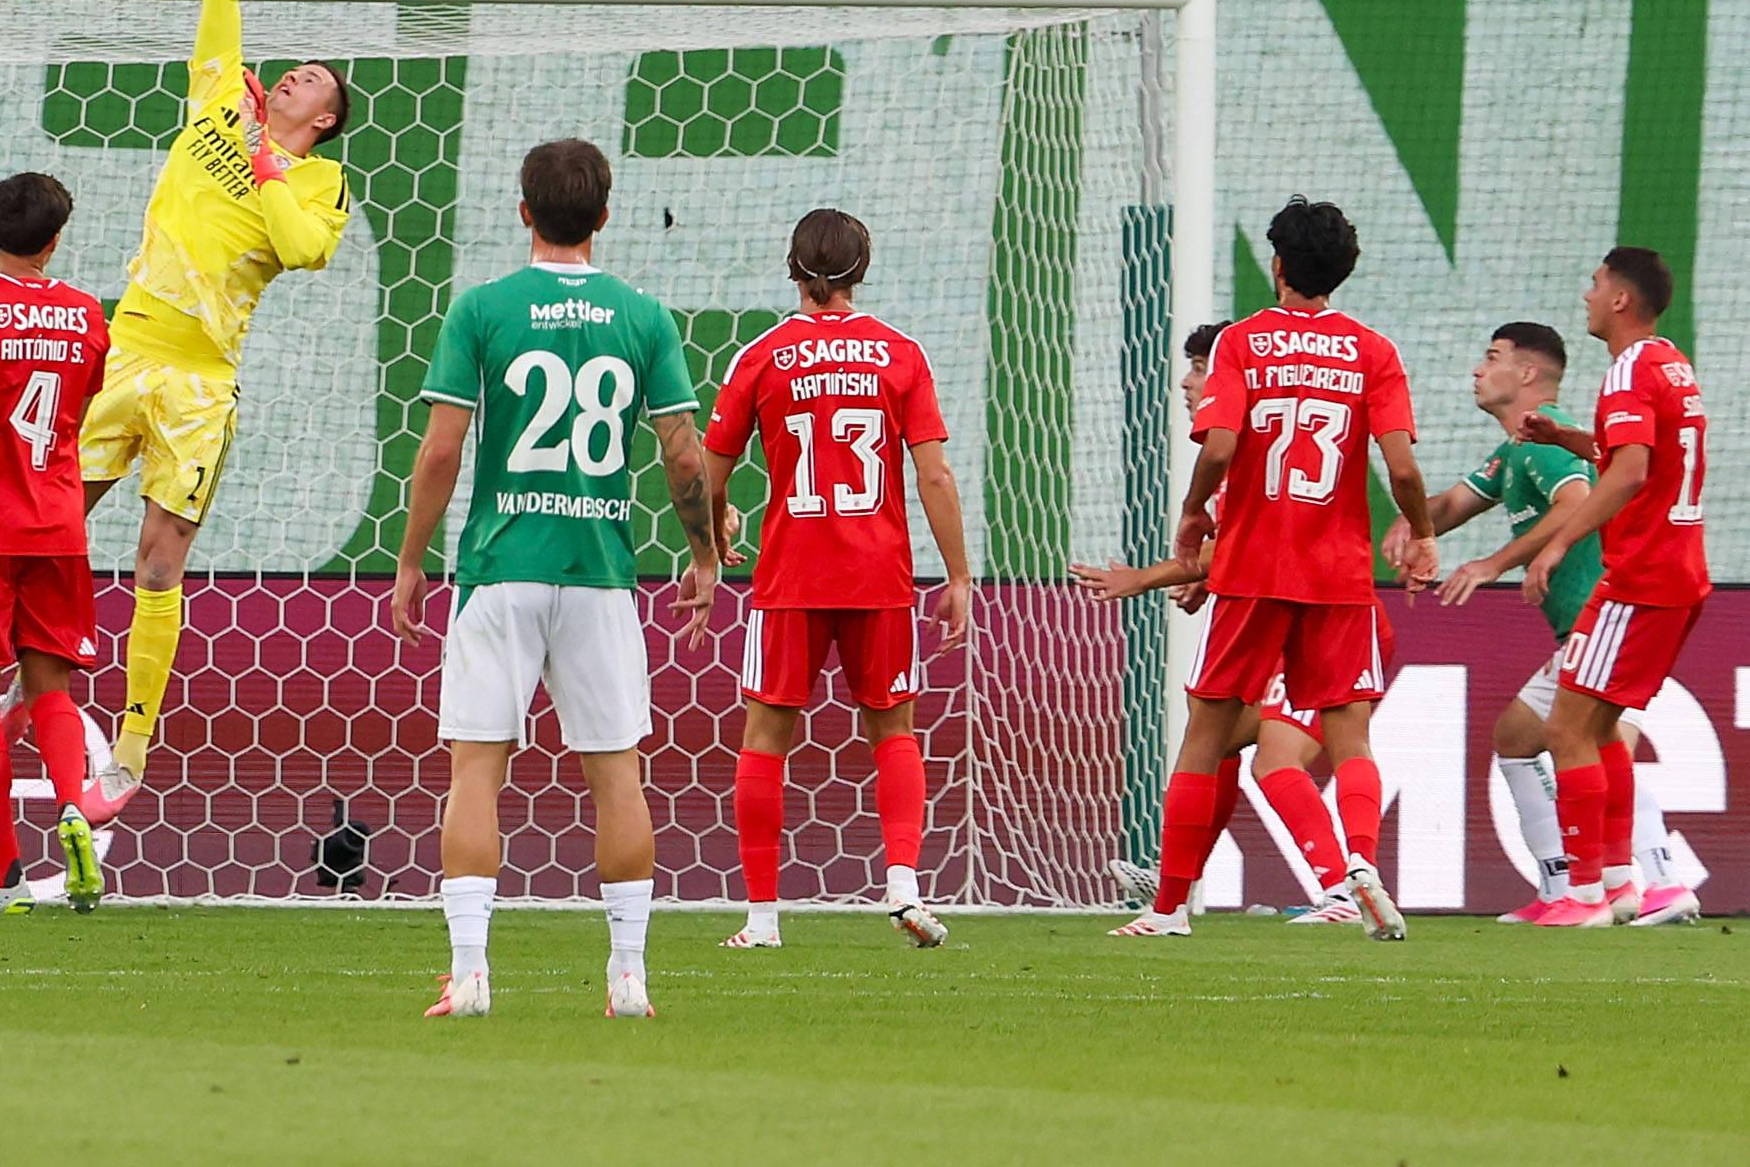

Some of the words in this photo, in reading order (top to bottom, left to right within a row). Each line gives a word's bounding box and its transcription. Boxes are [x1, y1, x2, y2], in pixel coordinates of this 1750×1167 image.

[186, 138, 212, 162] FLY
[204, 157, 250, 201] BETTER
[193, 117, 260, 192] Emira
[13, 302, 88, 335] SAGRES
[531, 297, 616, 324] Mettler
[1, 334, 67, 362] ANTÓNIO
[70, 342, 85, 364] S.
[799, 339, 891, 368] SAGRES
[1273, 330, 1359, 362] SAGRES
[790, 368, 878, 402] KAMIŃSKI
[1265, 363, 1364, 395] FIGUEIREDO
[9, 370, 61, 472] 4
[504, 350, 635, 477] 28
[785, 408, 886, 519] 13
[1250, 397, 1351, 506] 73
[186, 465, 206, 502] 1
[496, 491, 630, 521] VANDERMESCH
